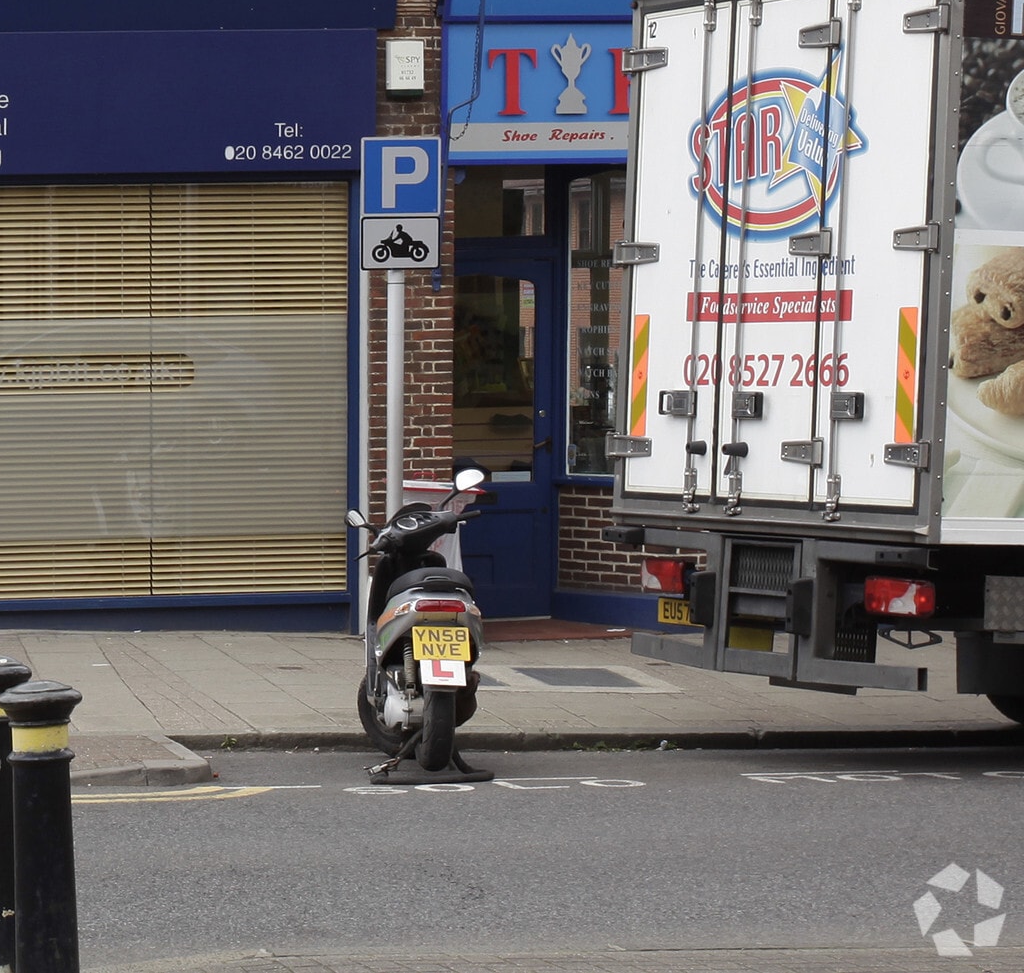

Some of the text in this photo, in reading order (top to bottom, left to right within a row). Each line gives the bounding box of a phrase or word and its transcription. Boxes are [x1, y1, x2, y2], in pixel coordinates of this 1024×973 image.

[405, 55, 421, 64] SPY
[274, 122, 304, 138] Tel:
[502, 128, 606, 144] Shoe Repairs
[261, 145, 304, 160] 8462
[309, 144, 352, 159] 0022
[692, 105, 783, 193] STAR
[797, 128, 825, 168] Valu
[381, 146, 430, 209] P
[689, 259, 706, 278] Te
[753, 257, 798, 279] Essential
[801, 255, 856, 280] Ingedint
[772, 296, 837, 319] Specialsts
[683, 352, 850, 387] 020 8527 2666
[663, 601, 690, 622] EU57
[414, 629, 467, 643] YN58
[421, 643, 462, 657] NVE
